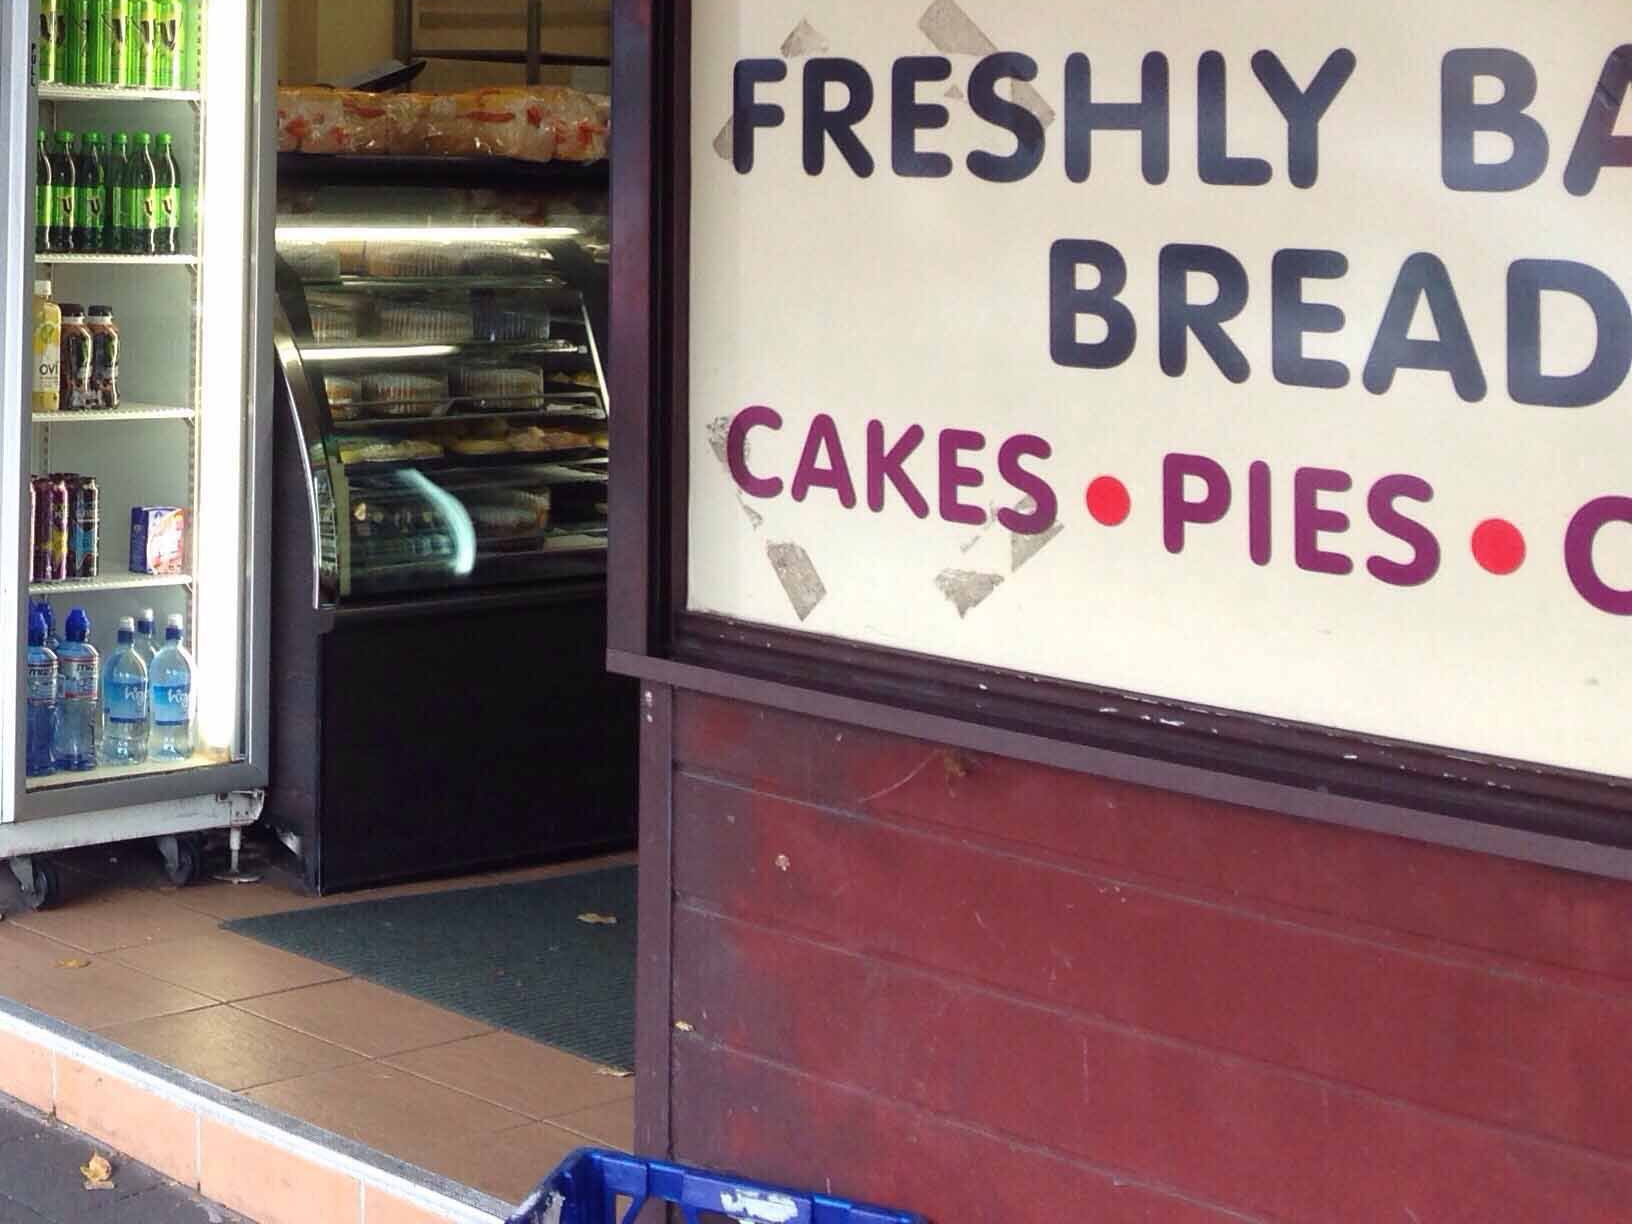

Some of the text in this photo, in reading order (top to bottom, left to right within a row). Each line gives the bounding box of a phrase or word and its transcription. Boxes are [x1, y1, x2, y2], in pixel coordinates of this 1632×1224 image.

[732, 47, 1356, 189] FRESHLY
[1049, 238, 1632, 408] BREAD
[726, 405, 1058, 536] CAKES
[1162, 453, 1441, 587] PIES
